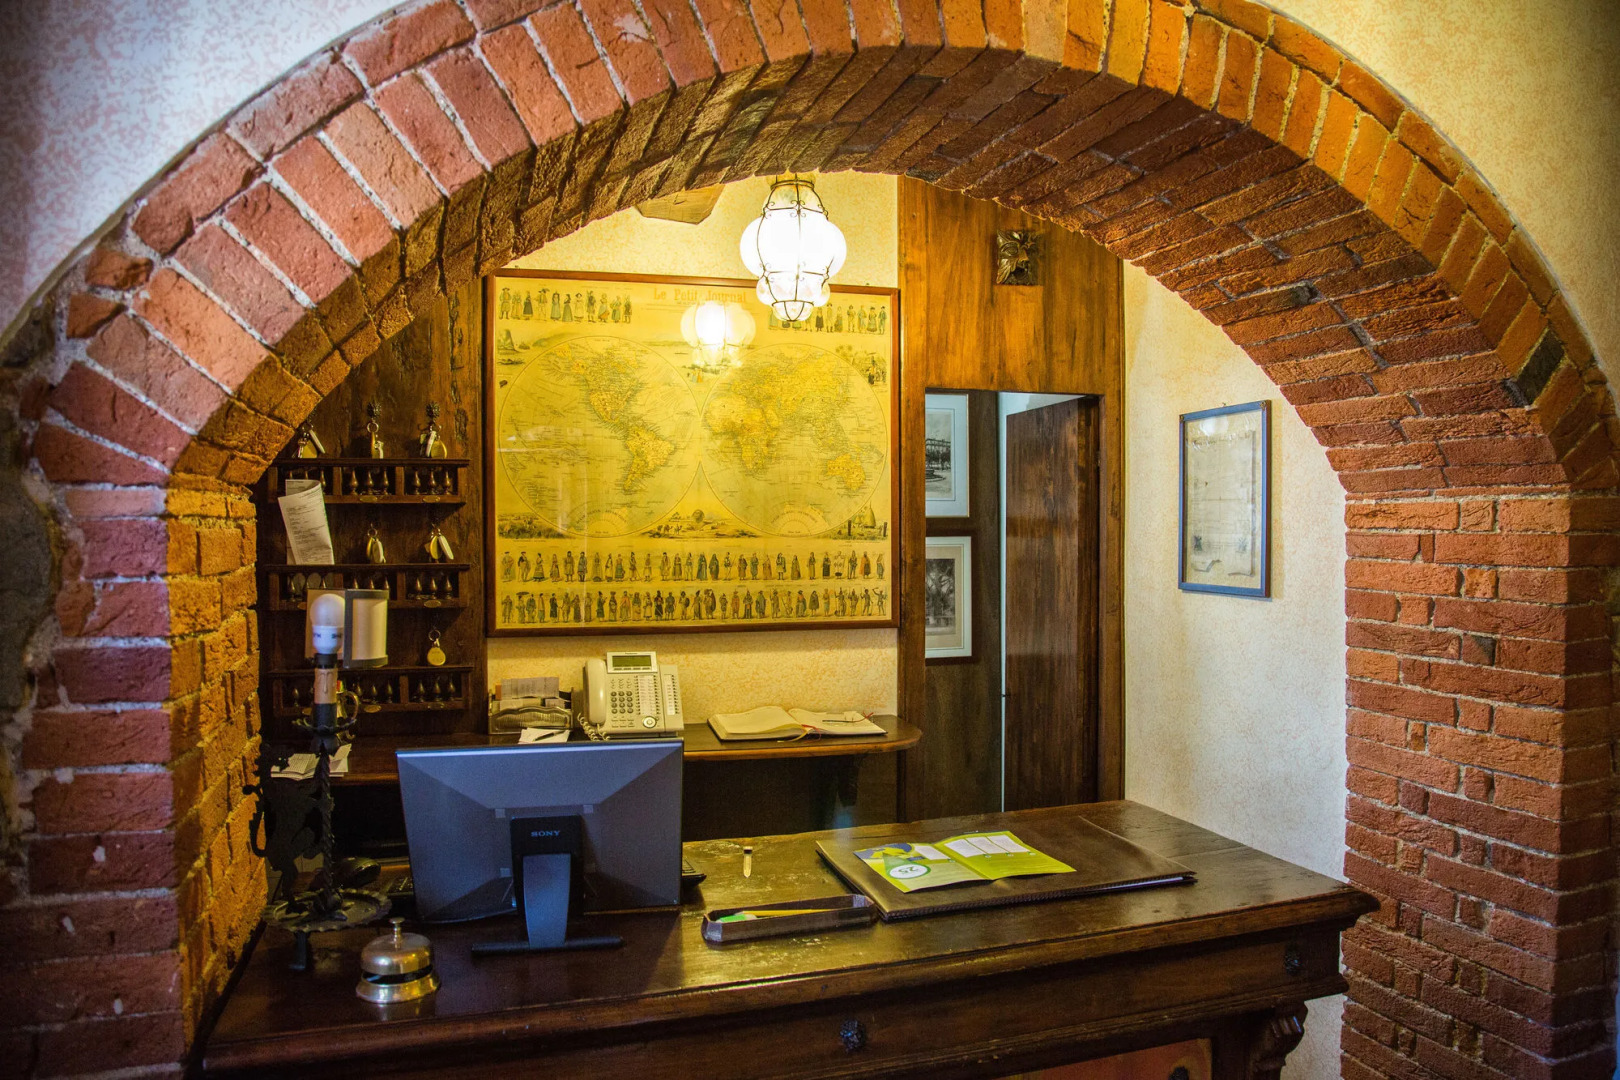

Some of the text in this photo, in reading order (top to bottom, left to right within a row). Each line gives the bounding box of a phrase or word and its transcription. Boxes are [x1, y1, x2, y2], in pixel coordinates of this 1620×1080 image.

[653, 288, 746, 304] Le Petit Journal
